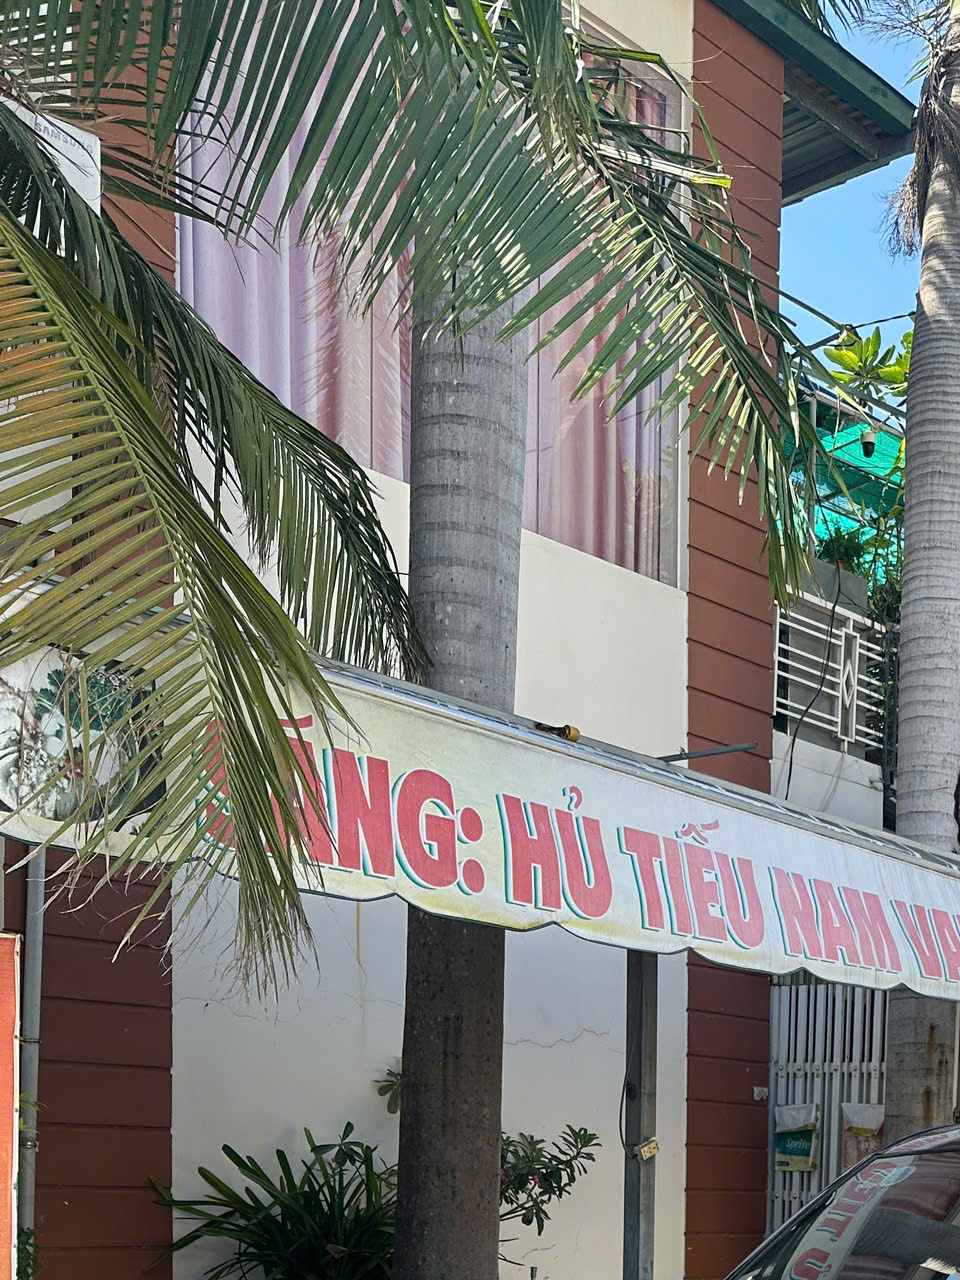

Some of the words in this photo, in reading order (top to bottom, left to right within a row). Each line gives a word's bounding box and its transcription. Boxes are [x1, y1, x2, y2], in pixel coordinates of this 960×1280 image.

[497, 785, 614, 920] HỦ
[617, 819, 766, 949] TIẾU
[768, 866, 902, 973] NAM
